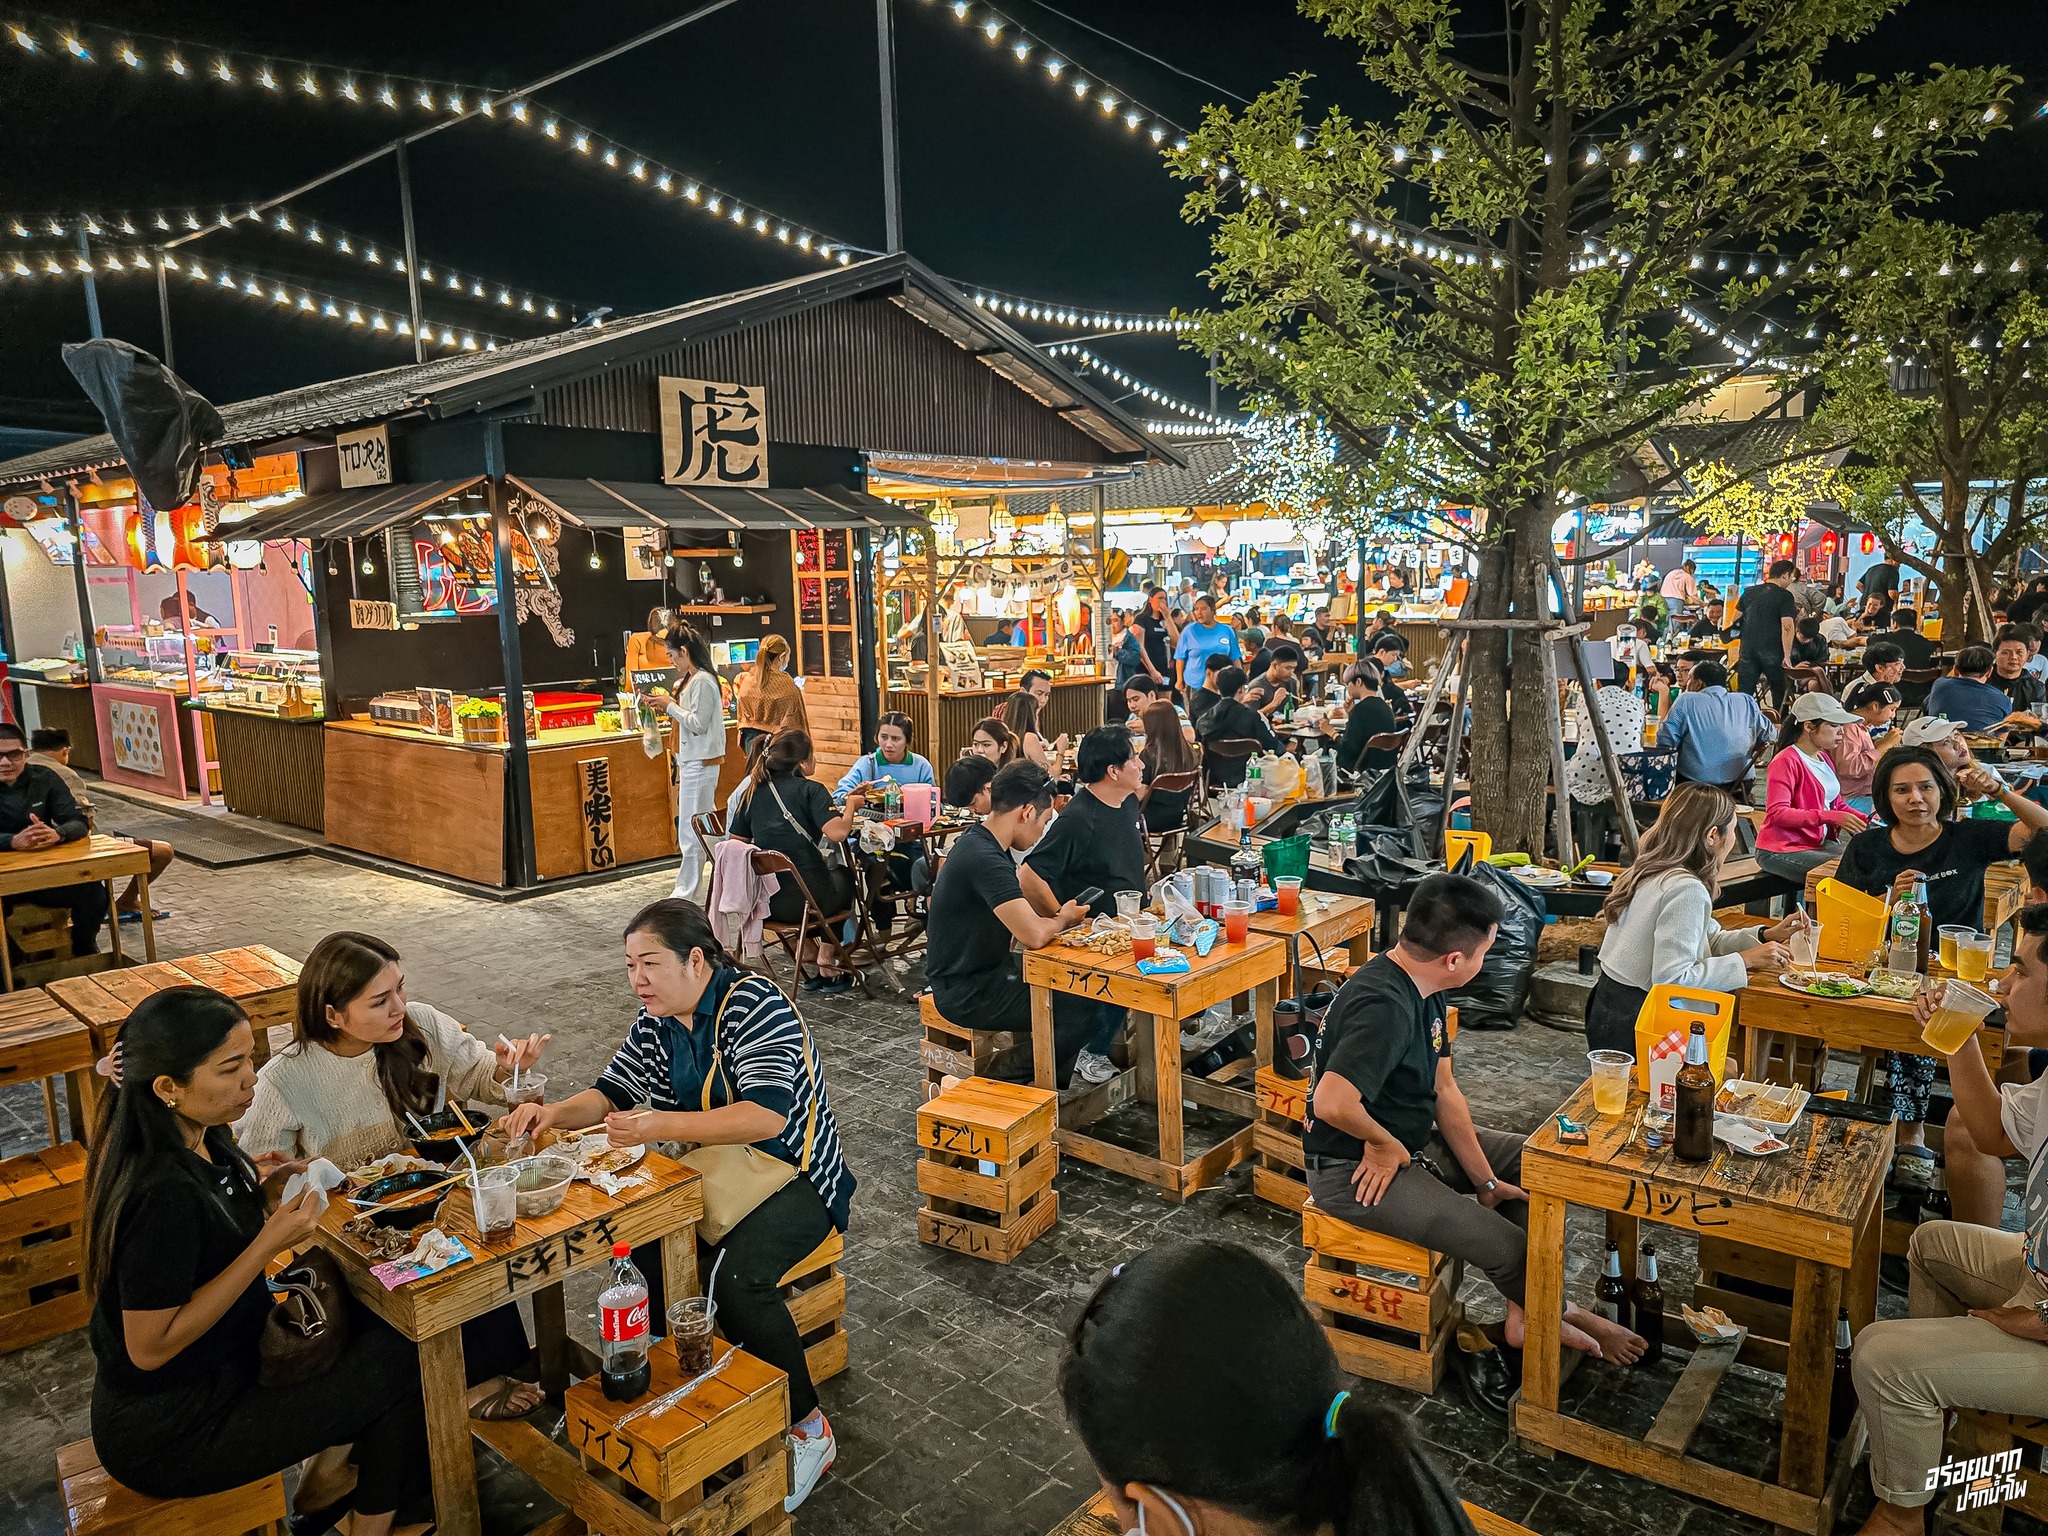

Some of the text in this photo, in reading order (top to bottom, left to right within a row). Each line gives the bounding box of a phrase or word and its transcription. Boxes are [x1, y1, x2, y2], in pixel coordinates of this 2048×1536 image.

[673, 386, 760, 483] 虎
[339, 436, 386, 473] TORA
[634, 672, 666, 684] 美味しい
[584, 760, 615, 867] 美味しい
[1838, 915, 1850, 956] SINGHA
[1067, 970, 1114, 998] ナイス
[924, 1047, 958, 1073] 小さな
[1268, 1090, 1306, 1120] ナイ
[932, 1120, 991, 1155] すごい
[1622, 1180, 1733, 1226] ハッピ
[931, 1219, 990, 1253] すごい
[506, 1217, 618, 1293] ドキドキ
[579, 1418, 639, 1484] ナイス
